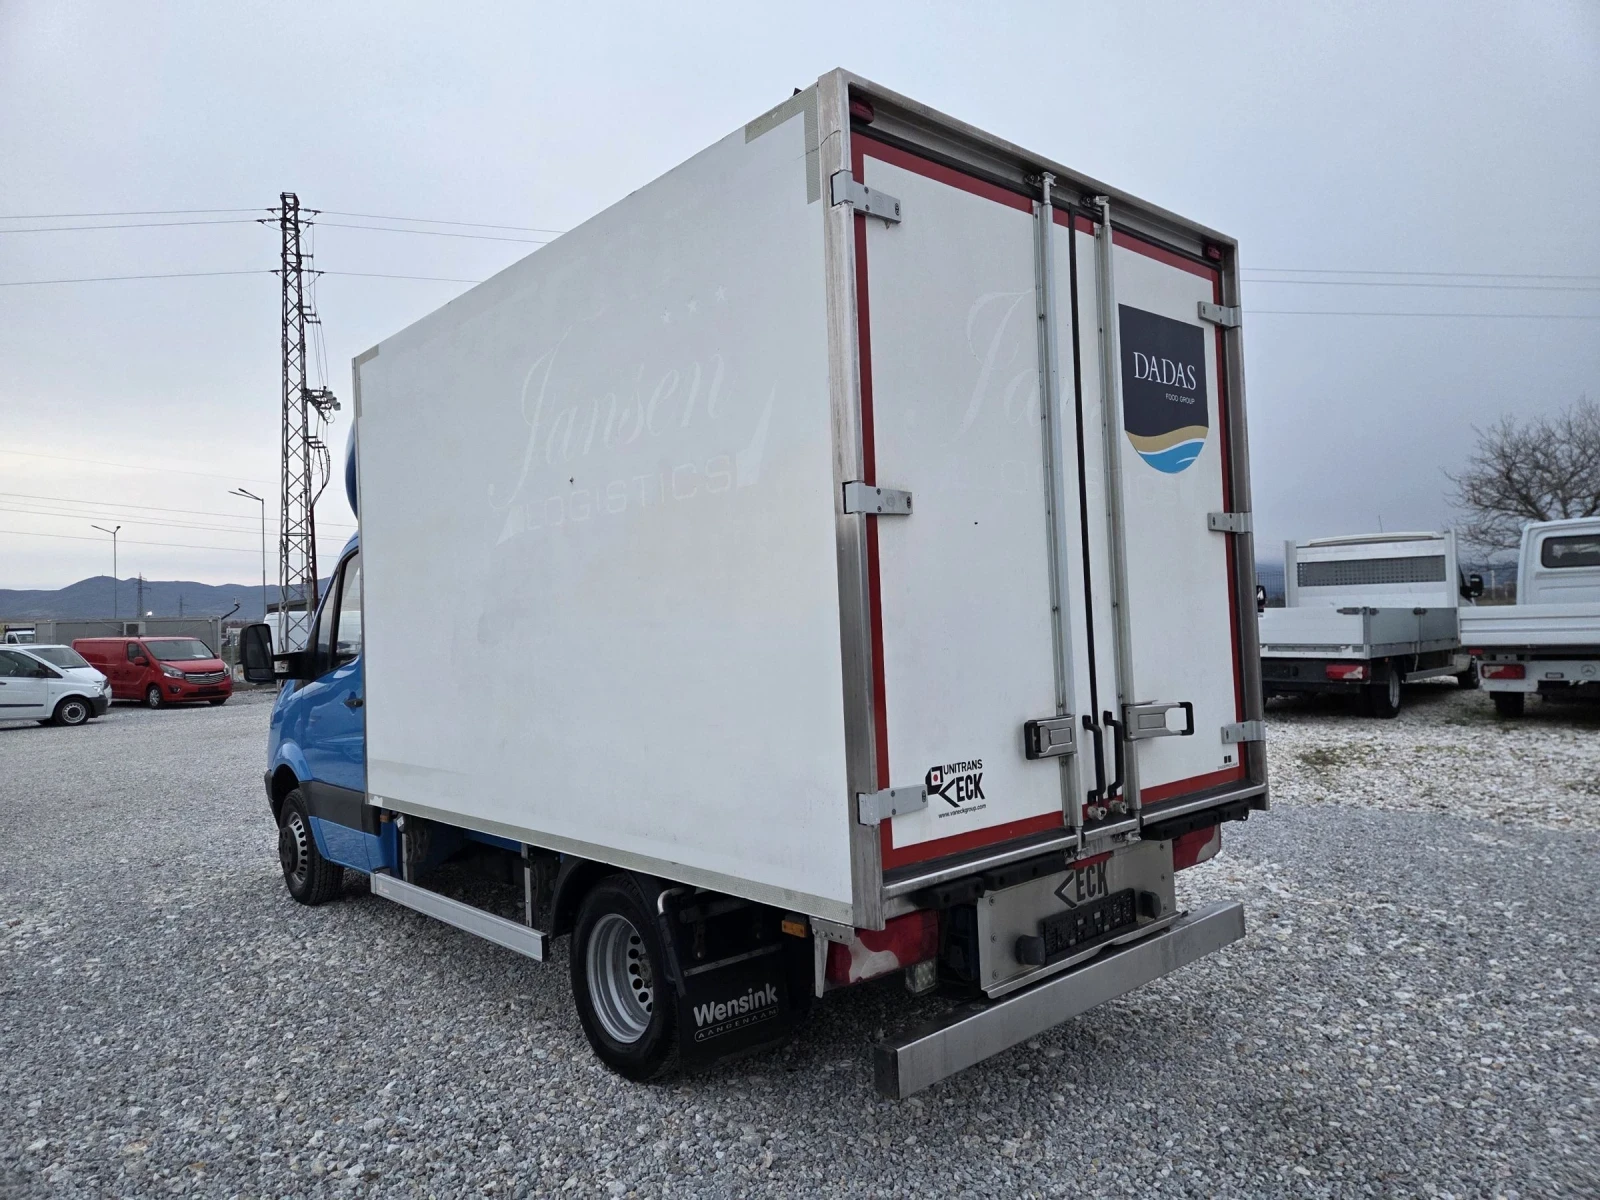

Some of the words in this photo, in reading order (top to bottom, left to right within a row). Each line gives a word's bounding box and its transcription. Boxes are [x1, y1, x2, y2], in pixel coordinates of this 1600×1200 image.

[1132, 351, 1197, 391] DADAS
[1165, 392, 1179, 403] FOOD
[1179, 395, 1196, 405] GROUP
[526, 454, 732, 532] LOGISTICS
[942, 758, 983, 776] UNITRANS
[693, 982, 779, 1028] Wensink
[697, 1008, 778, 1039] AANGENAAM
